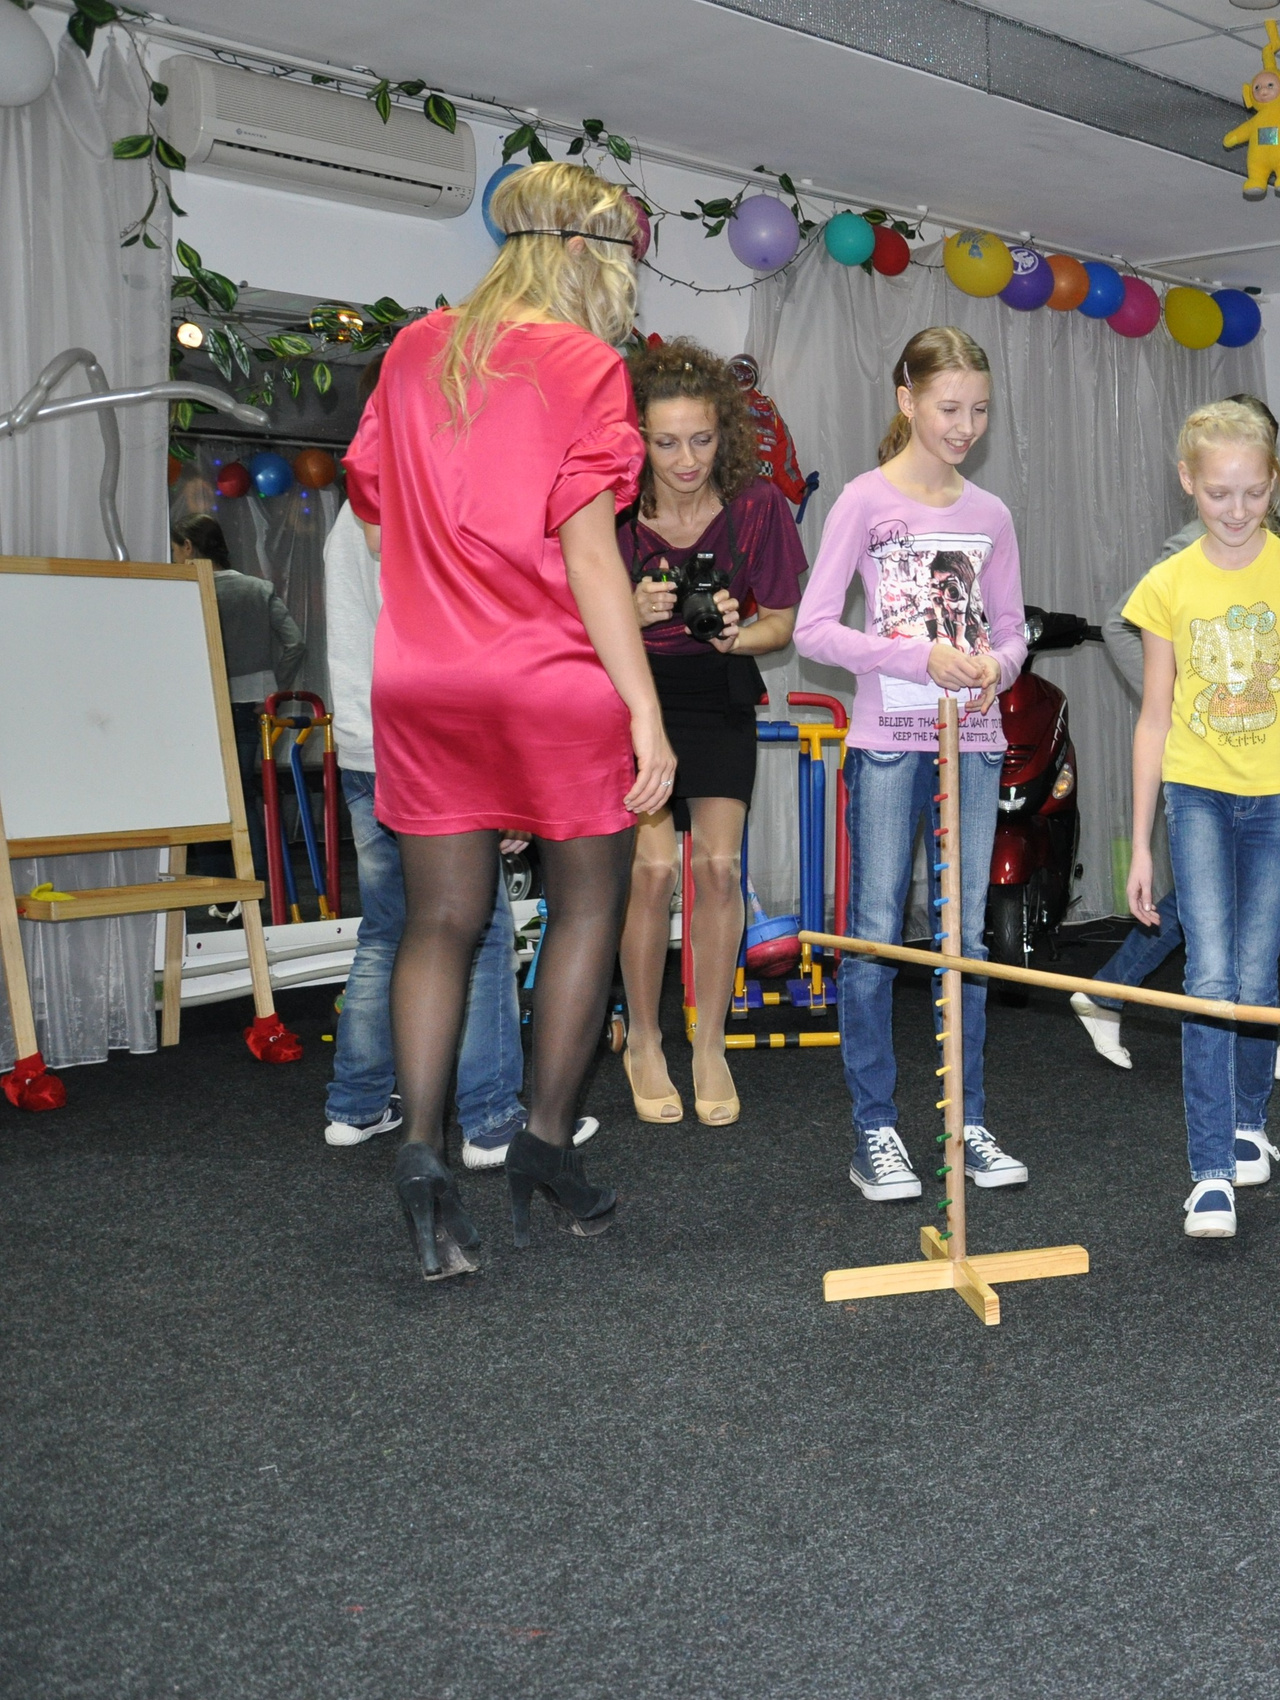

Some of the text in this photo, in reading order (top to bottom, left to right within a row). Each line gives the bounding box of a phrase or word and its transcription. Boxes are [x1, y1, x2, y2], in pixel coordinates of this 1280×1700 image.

[878, 716, 914, 727] BELIEVE
[970, 717, 988, 728] WANT
[893, 732, 911, 741] KEEP
[913, 733, 928, 741] THE
